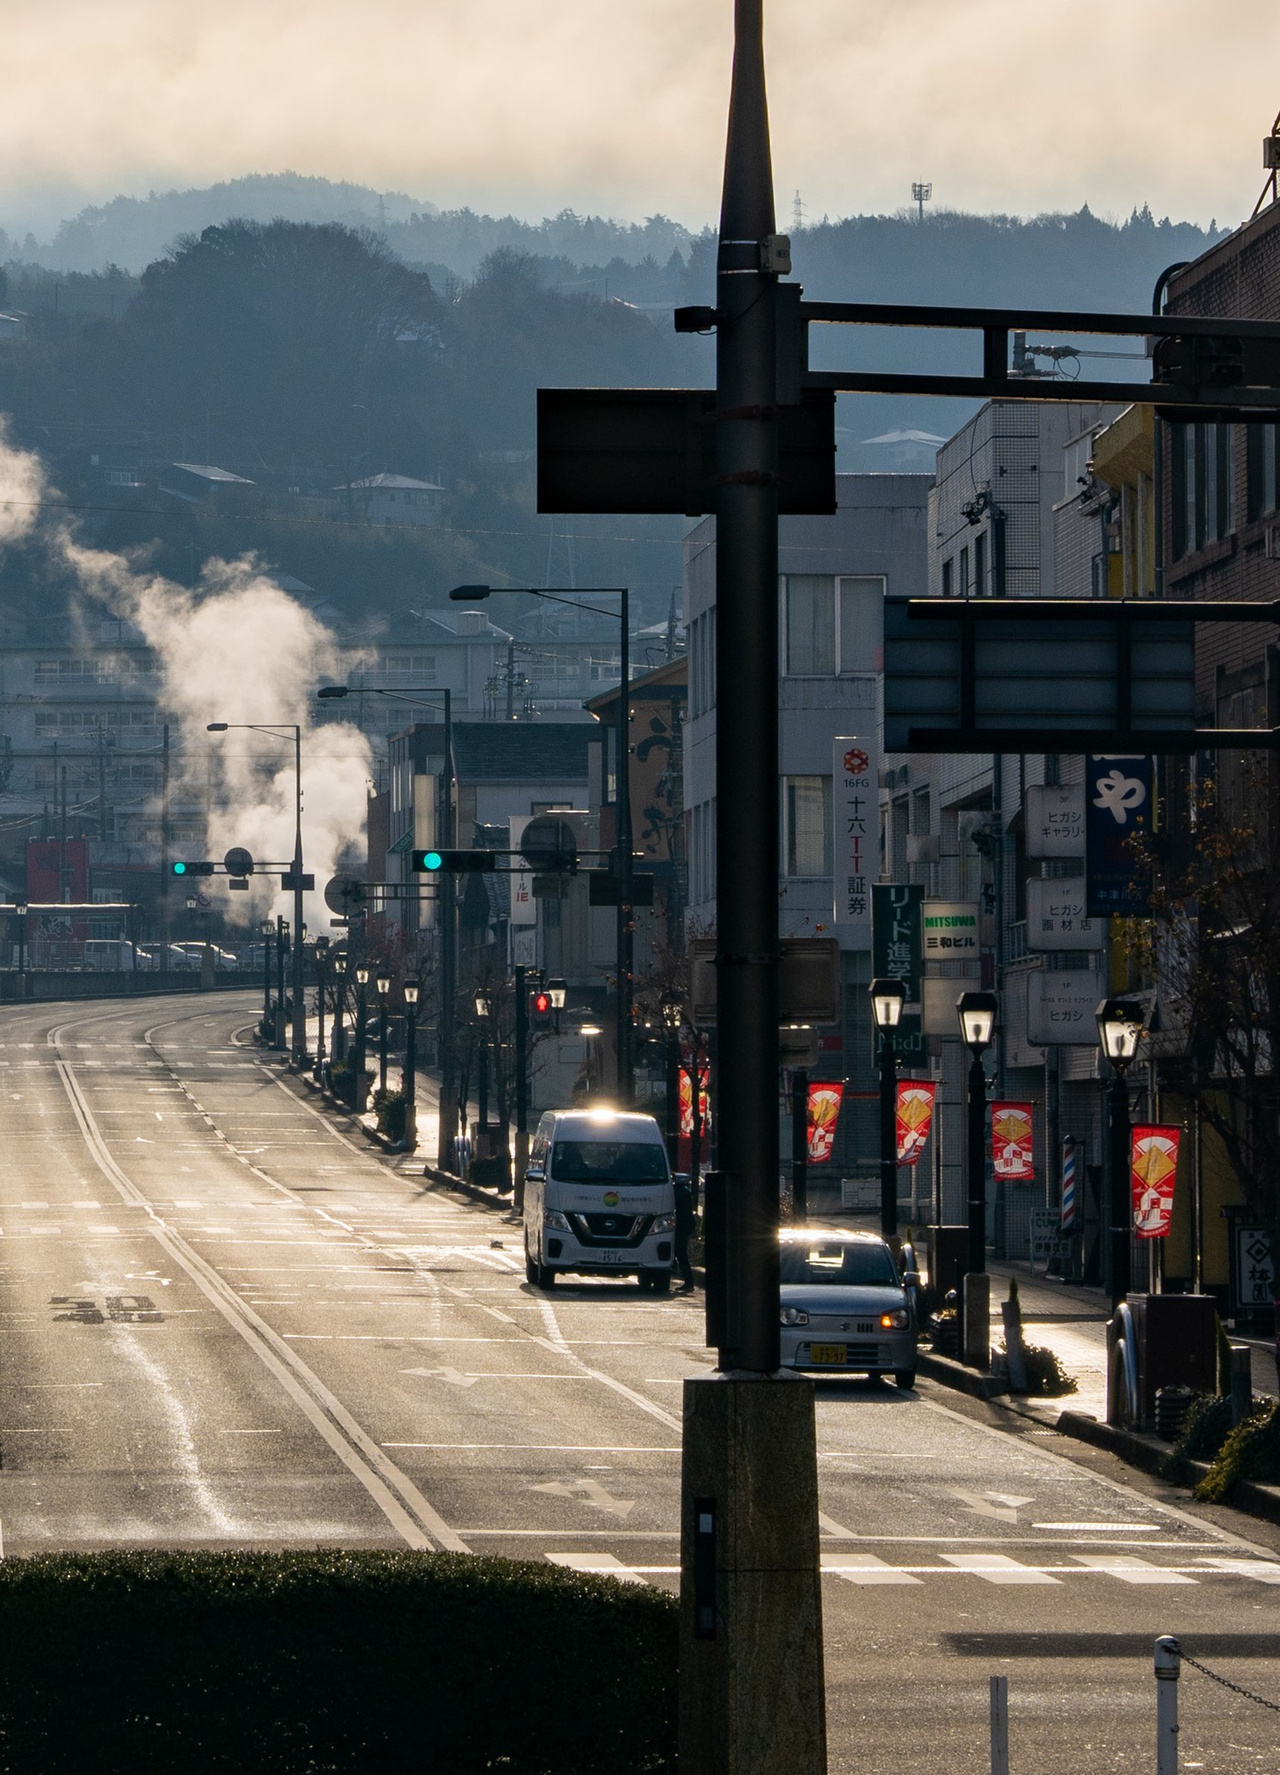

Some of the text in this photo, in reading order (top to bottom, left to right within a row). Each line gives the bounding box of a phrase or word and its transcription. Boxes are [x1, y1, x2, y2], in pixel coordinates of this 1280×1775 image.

[843, 777, 870, 789] 16FG
[1048, 812, 1082, 824] ヒガシ
[1041, 826, 1085, 838] ギャラリ
[1050, 904, 1083, 916] ヒガシ
[925, 915, 976, 928] MITSUWA
[926, 937, 975, 948] 三和ビル
[1050, 1010, 1083, 1022] ヒガシ
